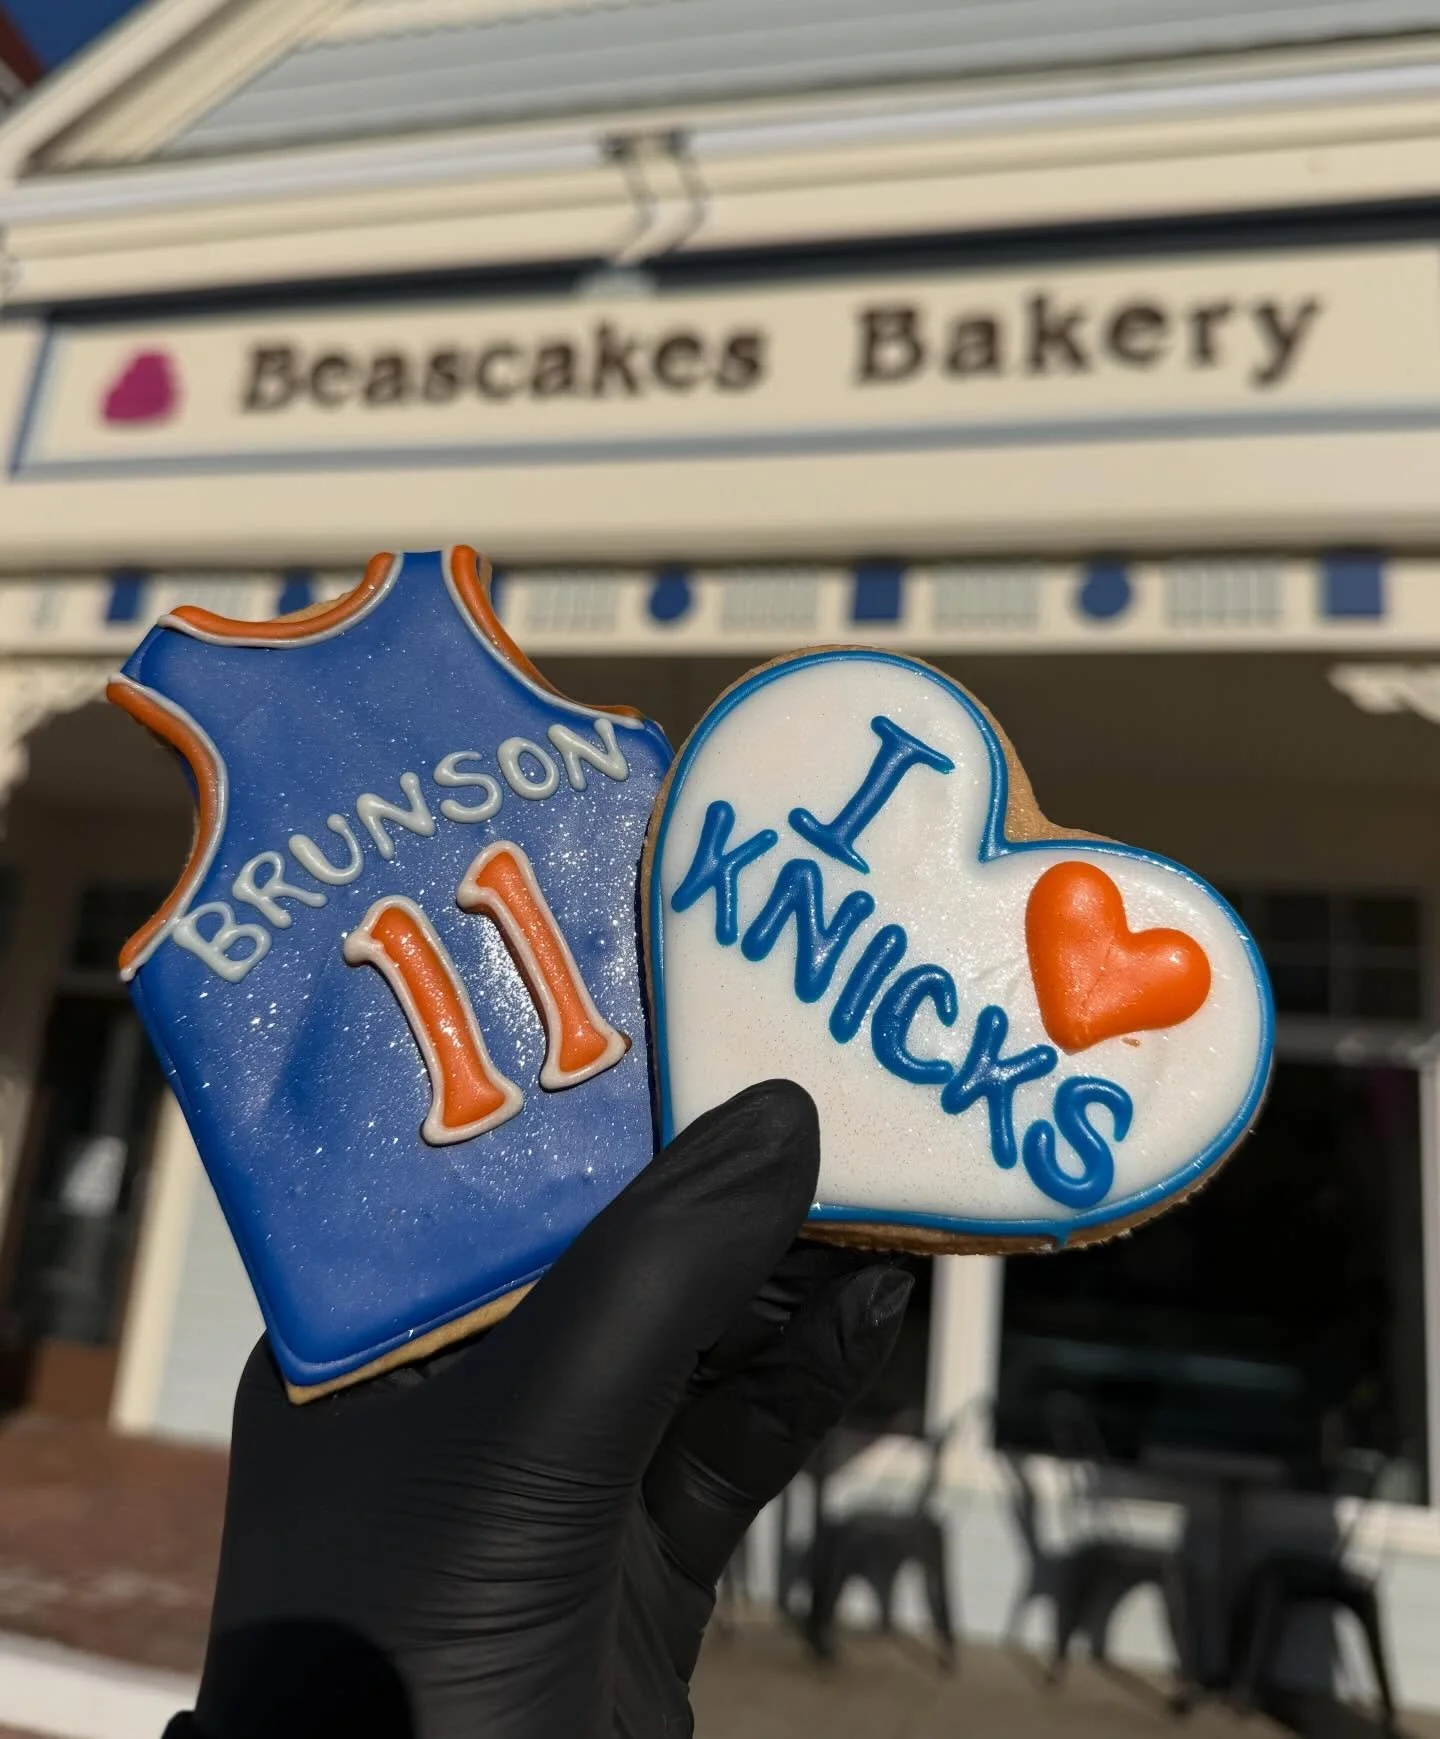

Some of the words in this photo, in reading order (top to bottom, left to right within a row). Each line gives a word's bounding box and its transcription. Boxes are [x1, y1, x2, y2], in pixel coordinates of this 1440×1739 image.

[242, 318, 767, 413] Beascakes
[855, 291, 1321, 388] Bakery
[172, 718, 630, 982] BRUNSON
[788, 715, 955, 873] I
[343, 840, 630, 1146] 11
[671, 800, 1133, 1208] KNICKS
